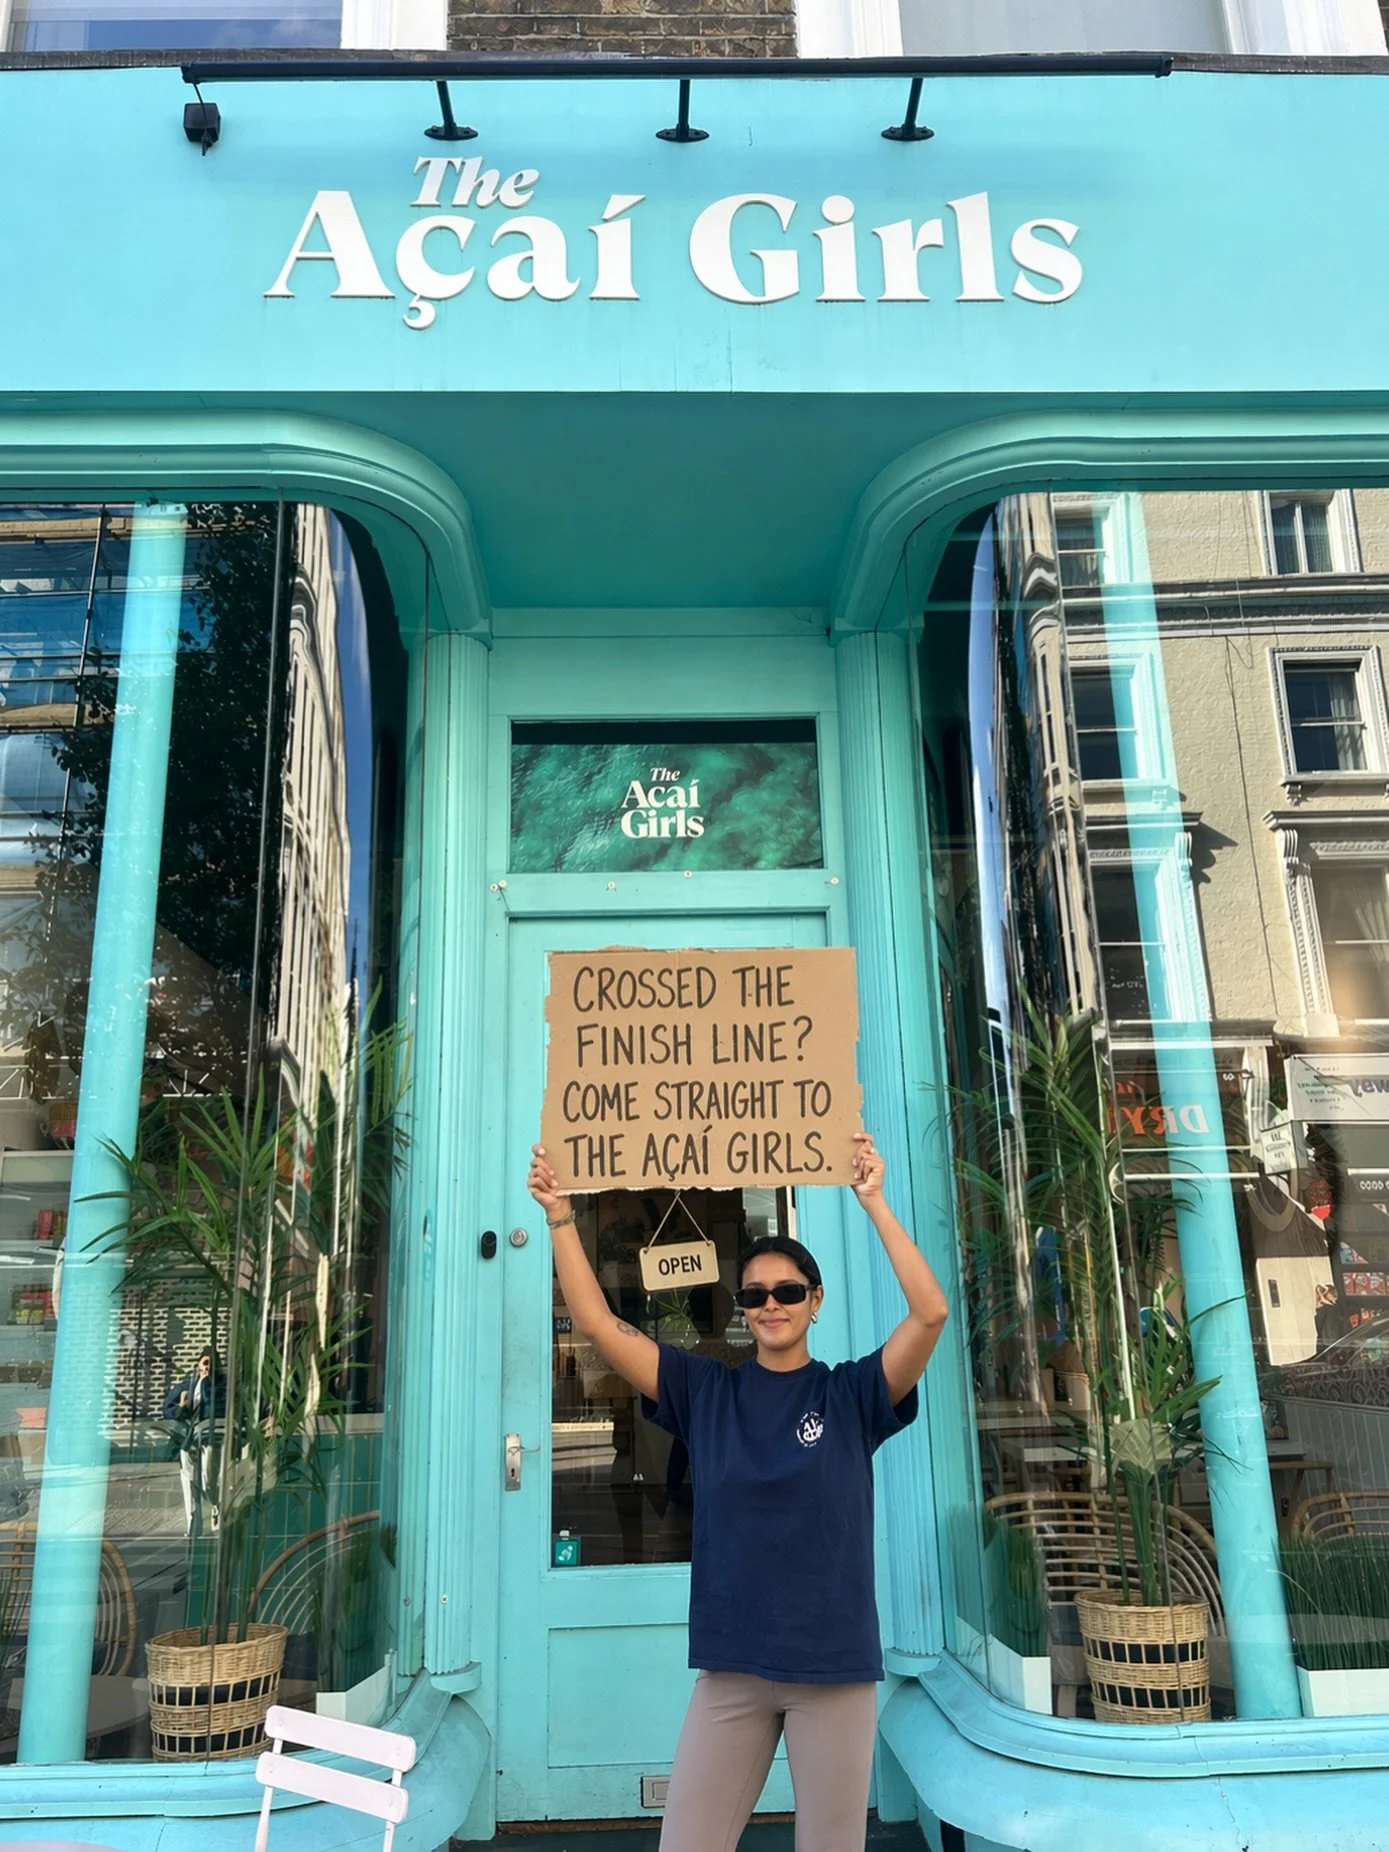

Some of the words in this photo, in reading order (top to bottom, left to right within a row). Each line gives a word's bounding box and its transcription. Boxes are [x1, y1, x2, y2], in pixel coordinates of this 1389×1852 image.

[410, 156, 540, 207] The
[263, 189, 646, 330] Açaí
[689, 191, 1083, 304] Girls
[650, 767, 681, 782] The
[621, 809, 705, 839] Girls
[574, 966, 717, 1013] CROSSED
[732, 965, 795, 1008] THE
[577, 1023, 692, 1067] FINISH
[712, 1015, 813, 1065] LINE?
[563, 1080, 640, 1123] COME
[654, 1079, 785, 1121] STRAIGHT
[793, 1079, 832, 1118] TO
[564, 1133, 626, 1178] THE
[642, 1124, 713, 1182] AÇAÍ
[727, 1131, 833, 1174] GIRLS.
[658, 1254, 702, 1276] OPEN
